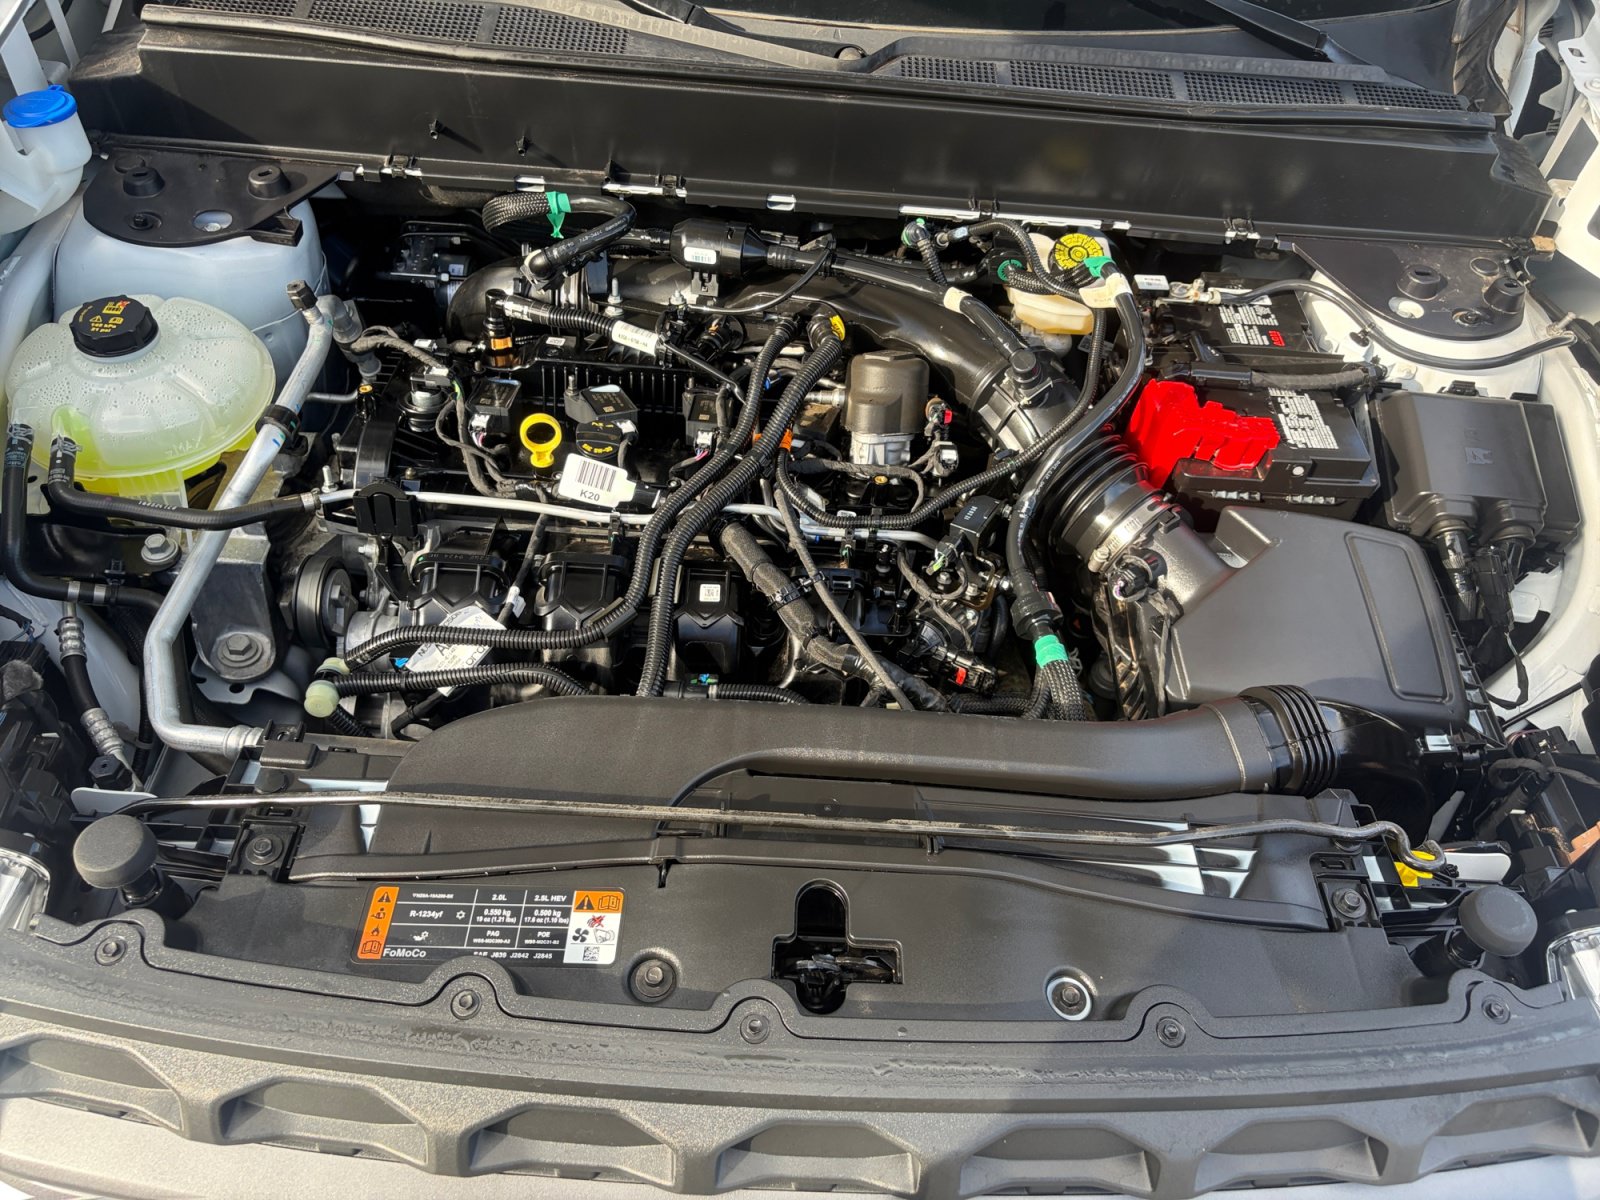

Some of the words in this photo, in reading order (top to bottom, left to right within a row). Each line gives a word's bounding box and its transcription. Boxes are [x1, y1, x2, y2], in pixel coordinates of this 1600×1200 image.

[579, 489, 600, 502] K20
[409, 910, 444, 919] R-1234yf
[502, 909, 511, 917] kg
[552, 910, 562, 918] kg
[491, 916, 505, 924] (1.21
[505, 916, 517, 924] lbs)
[382, 948, 427, 958] FoMoCo
